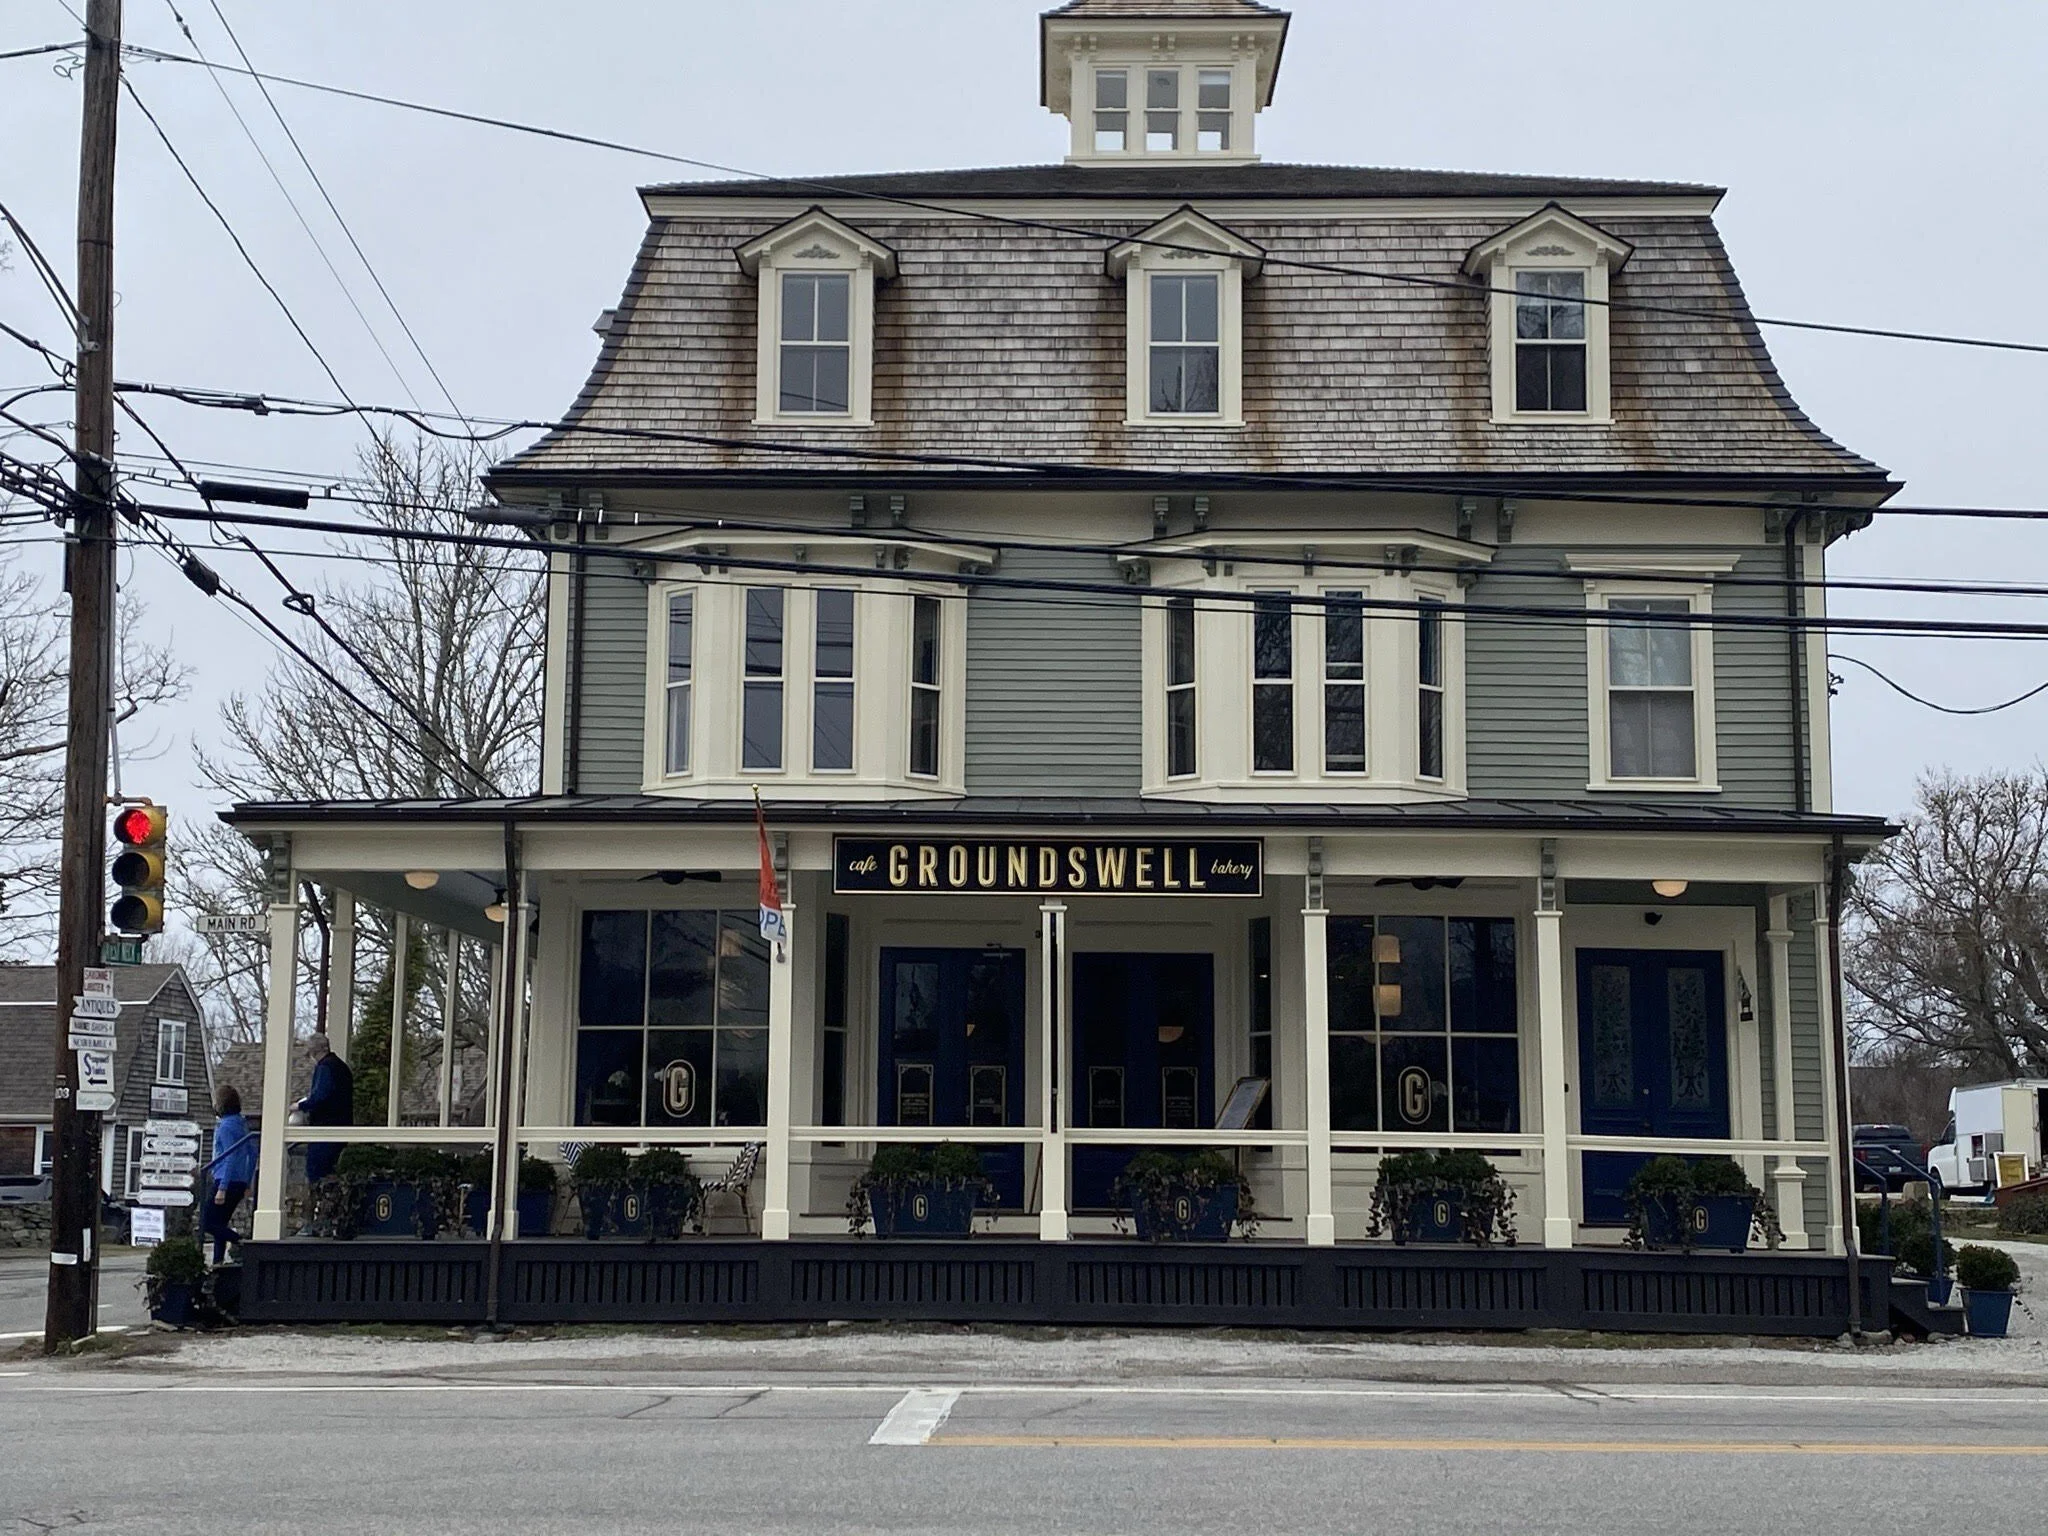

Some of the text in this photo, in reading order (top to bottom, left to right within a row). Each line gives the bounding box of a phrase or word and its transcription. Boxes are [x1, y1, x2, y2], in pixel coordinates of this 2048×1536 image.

[849, 845, 1253, 888] cafe GROUNDSWELL bakery
[207, 916, 256, 930] MAIN RD
[81, 999, 116, 1014] ANTIQUES
[670, 1067, 689, 1110] G
[1405, 1073, 1424, 1118] G
[379, 1197, 388, 1218] G
[627, 1197, 636, 1218] G
[916, 1197, 925, 1218] G
[1178, 1199, 1187, 1219] G
[1437, 1203, 1446, 1224] G
[1696, 1209, 1705, 1230] G
